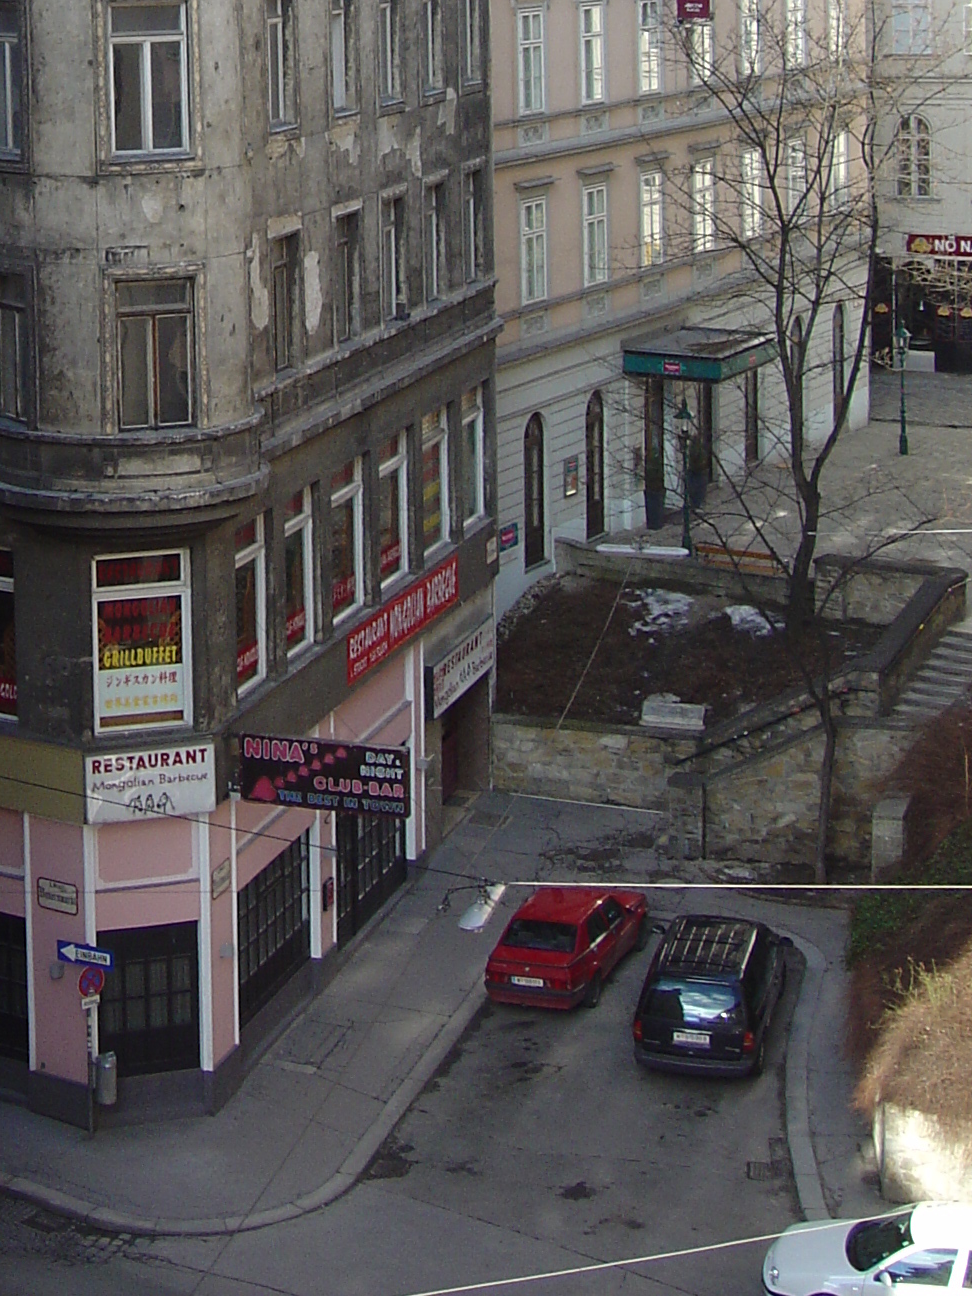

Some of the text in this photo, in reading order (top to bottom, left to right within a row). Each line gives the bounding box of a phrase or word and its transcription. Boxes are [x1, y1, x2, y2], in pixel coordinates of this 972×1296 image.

[960, 239, 972, 253] N
[349, 612, 388, 661] RESTAURANT
[389, 587, 424, 644] MONGOLIAN
[426, 561, 457, 614] BARBECUE
[103, 645, 178, 668] GRILLBUFFET
[442, 631, 483, 675] RESTAURANT
[91, 748, 208, 775] RESTAURANT
[243, 737, 319, 764] NINA'S
[365, 751, 395, 765] DAY
[91, 772, 208, 793] Mongolian Barbecue
[359, 764, 404, 780] NIGHT
[313, 775, 405, 799] CLUB-BAR
[278, 789, 405, 814] THE BEST IN TOWN
[75, 949, 108, 965] EINBAHN
